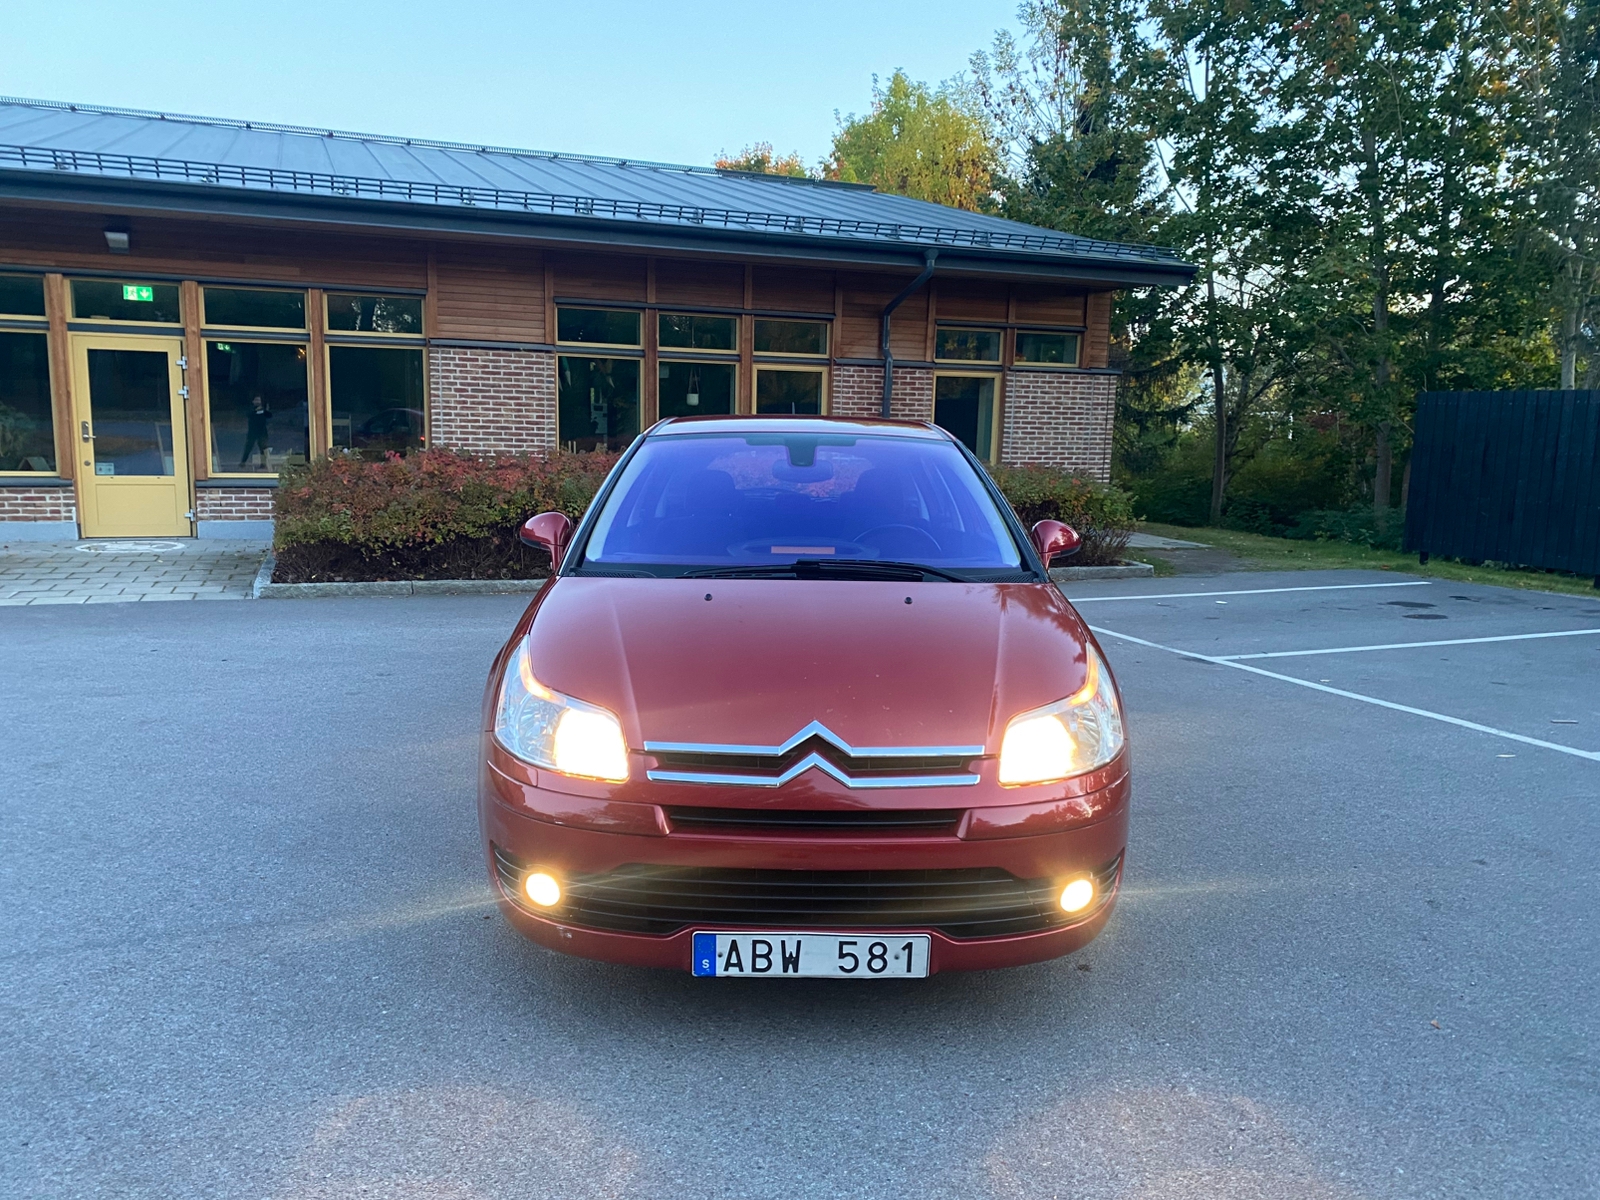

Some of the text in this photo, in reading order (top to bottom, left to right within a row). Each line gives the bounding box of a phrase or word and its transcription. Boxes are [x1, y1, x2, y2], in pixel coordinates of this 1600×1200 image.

[702, 959, 710, 969] S
[723, 939, 914, 974] ABW 581
